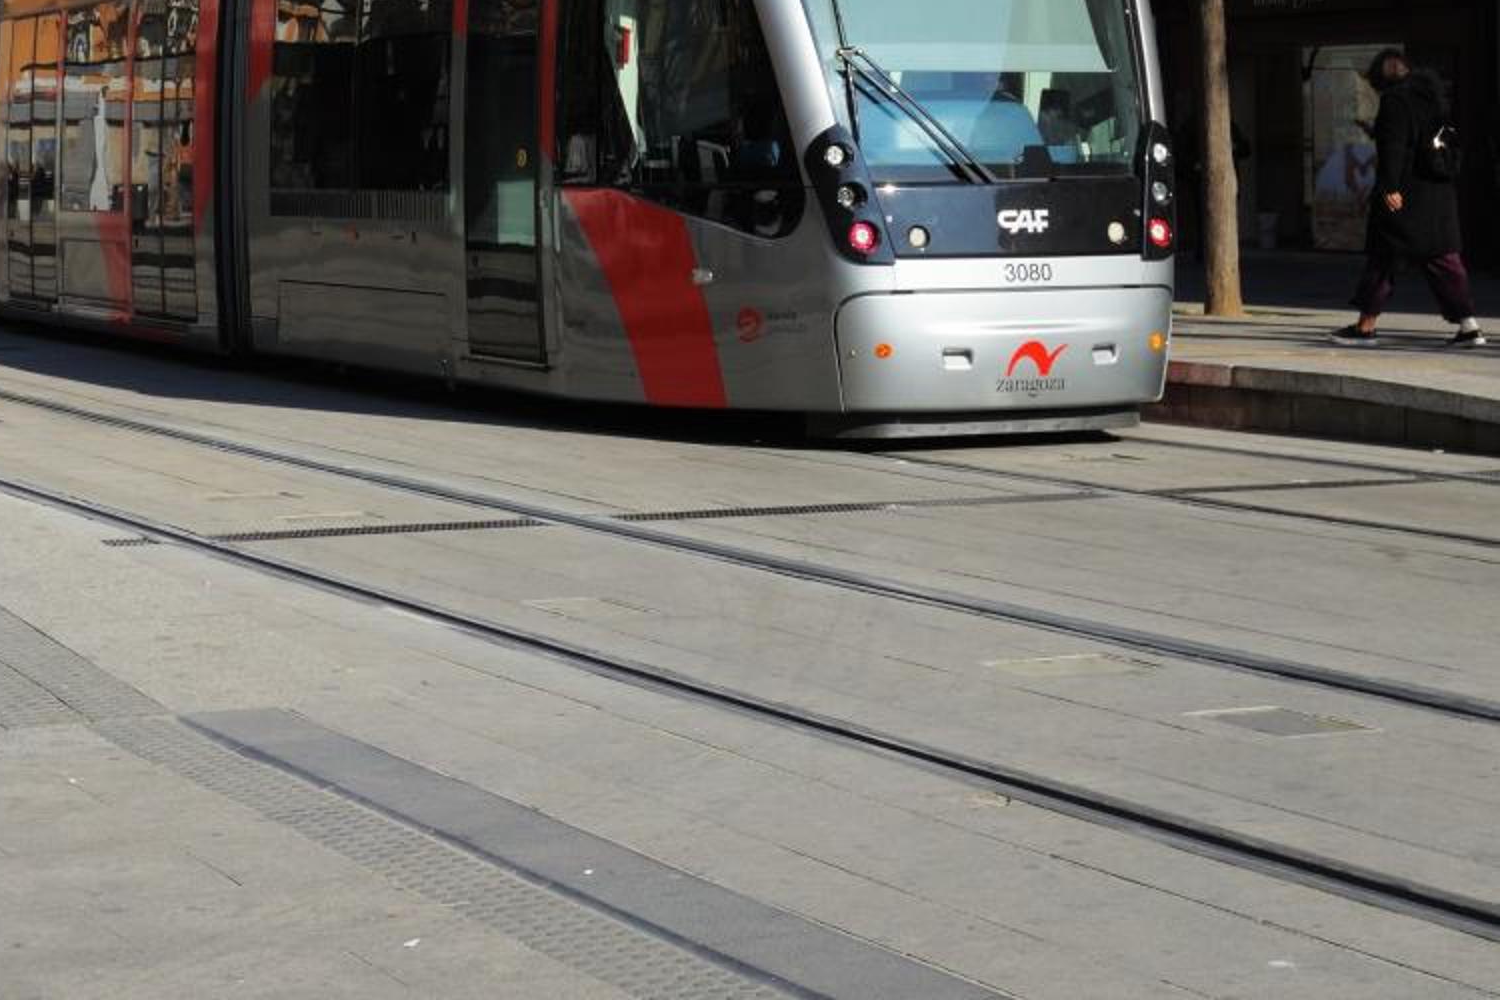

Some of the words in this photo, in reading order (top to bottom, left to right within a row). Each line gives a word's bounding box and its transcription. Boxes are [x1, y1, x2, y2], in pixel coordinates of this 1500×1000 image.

[997, 209, 1049, 234] CAF
[1004, 263, 1053, 283] 3080
[996, 377, 1066, 398] zaragoza
